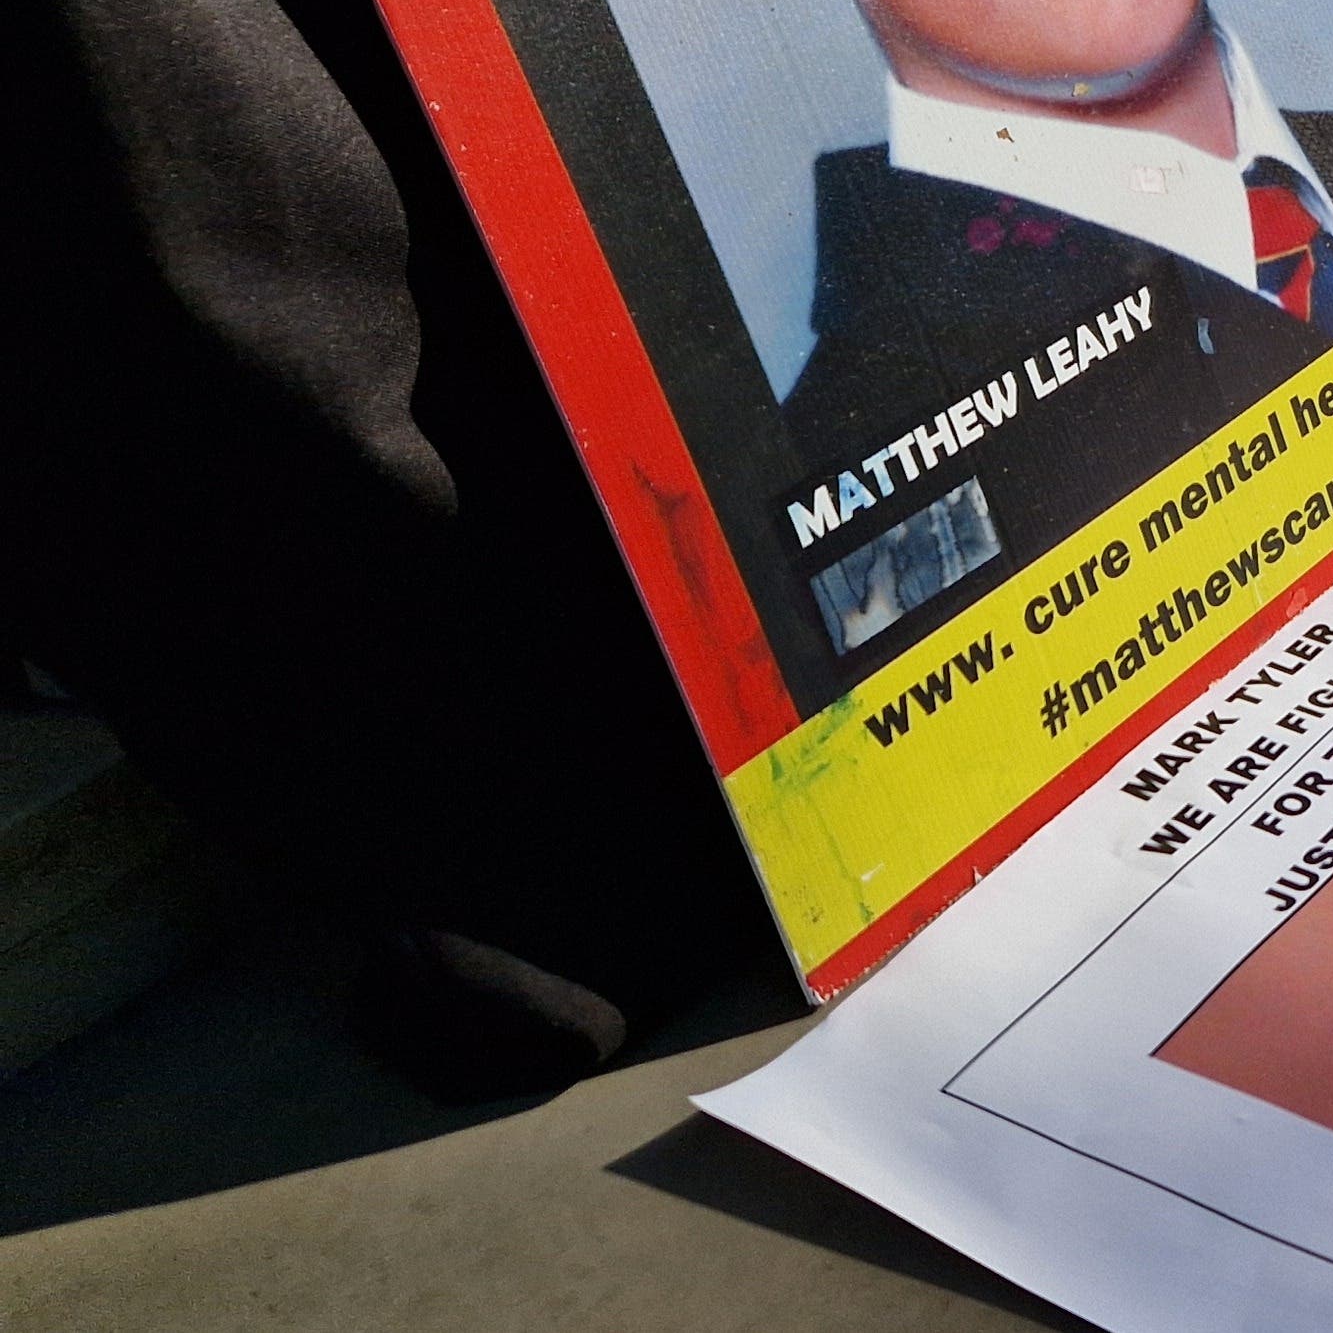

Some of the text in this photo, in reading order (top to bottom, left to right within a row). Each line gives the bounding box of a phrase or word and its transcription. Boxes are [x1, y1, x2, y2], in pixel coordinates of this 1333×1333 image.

[786, 285, 1155, 549] MATTHEW LEAHY
[862, 628, 1016, 748] www.
[1022, 537, 1132, 637] cure
[1137, 412, 1288, 540] mental
[1120, 710, 1240, 802] MARK
[1138, 802, 1216, 857] WE
[1207, 735, 1289, 804] ARE
